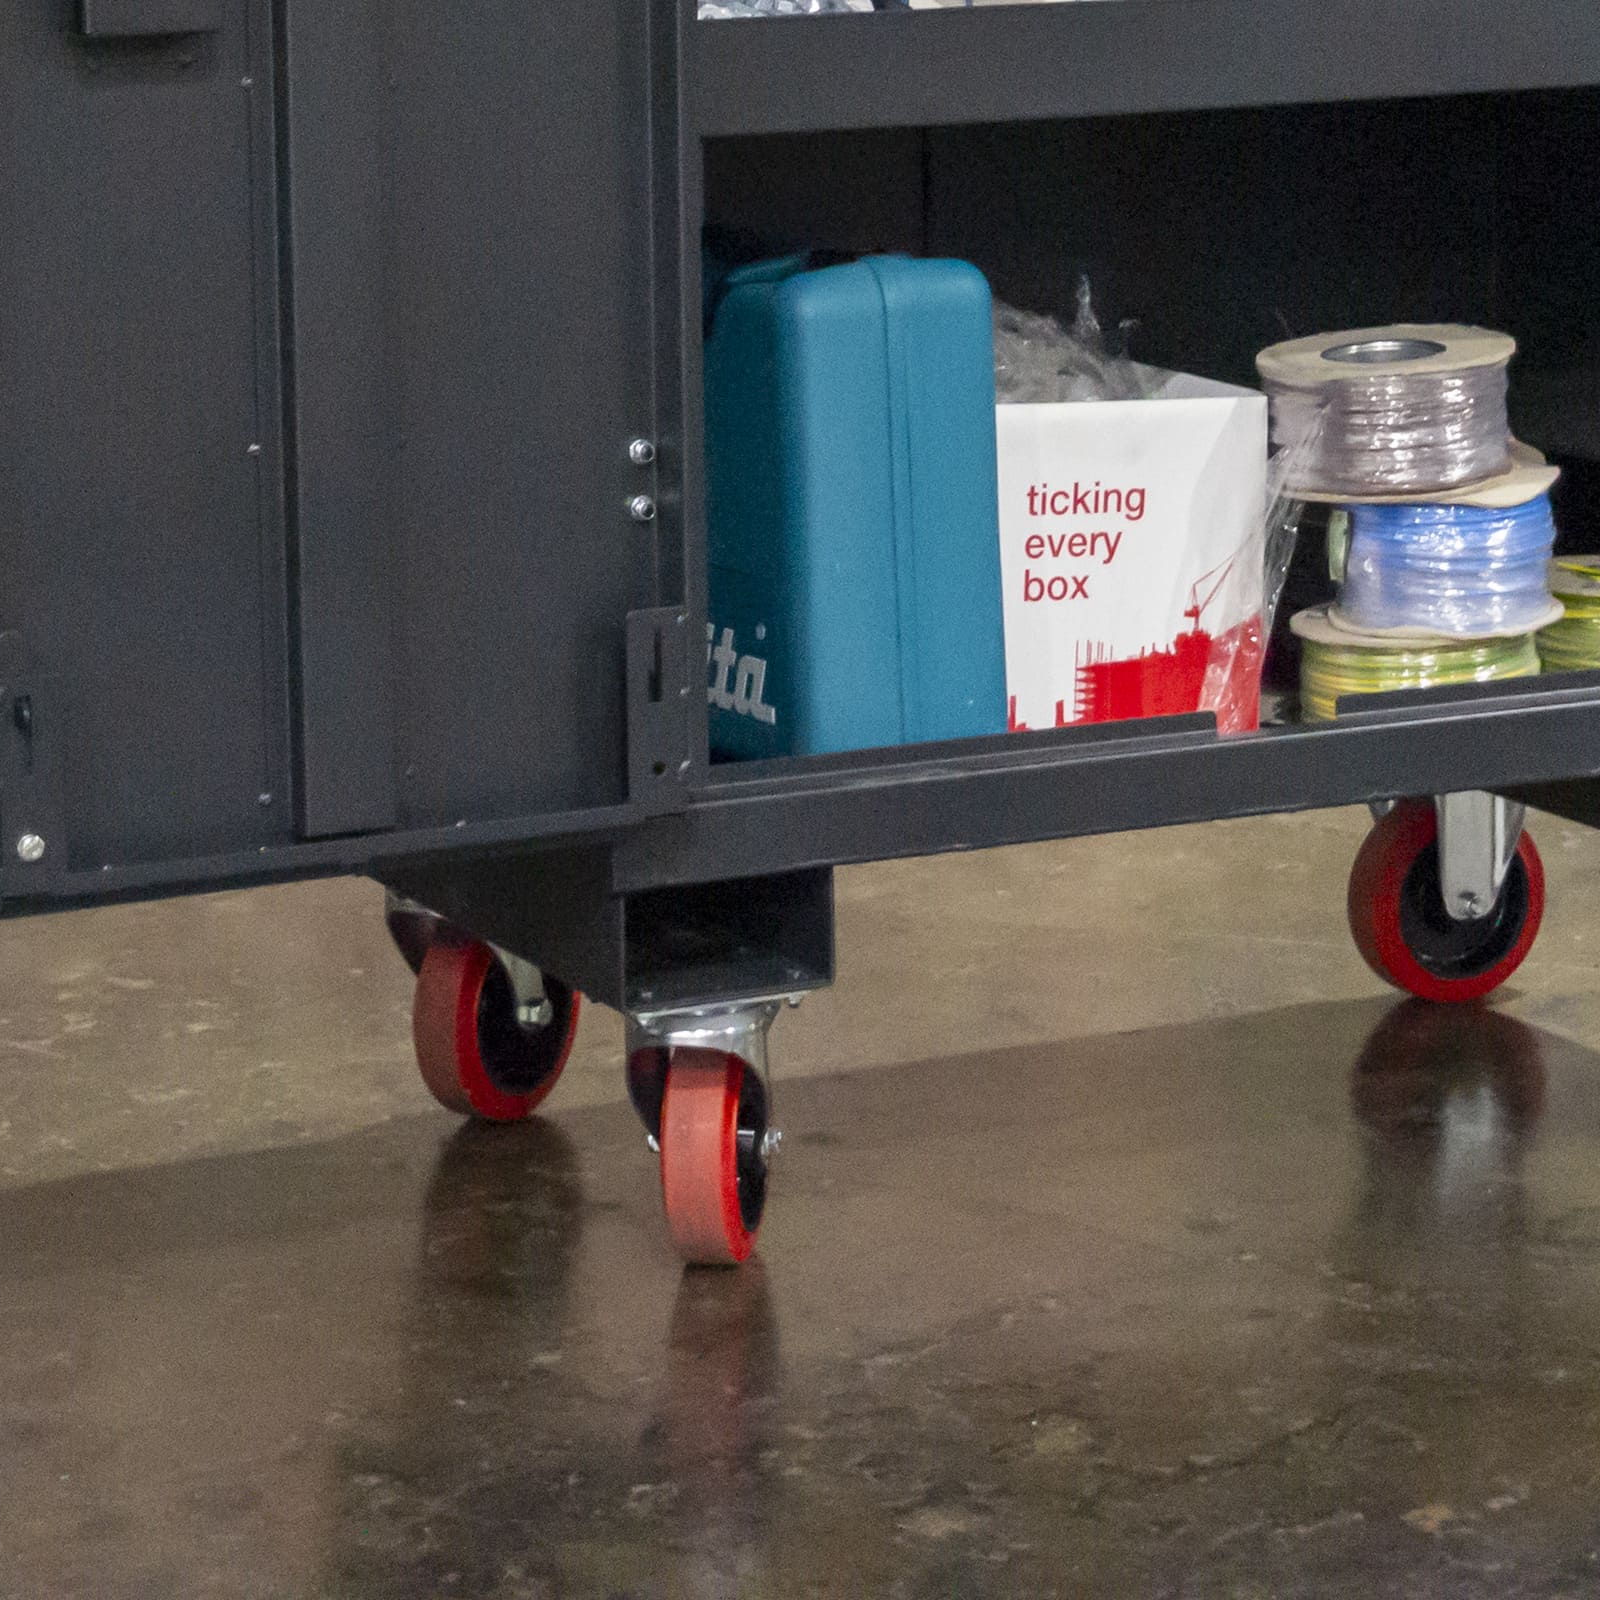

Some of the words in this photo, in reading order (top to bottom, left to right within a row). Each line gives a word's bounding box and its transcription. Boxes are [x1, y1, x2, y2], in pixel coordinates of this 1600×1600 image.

[1026, 480, 1146, 521] ticking
[1024, 531, 1123, 565] every
[1023, 568, 1090, 602] box
